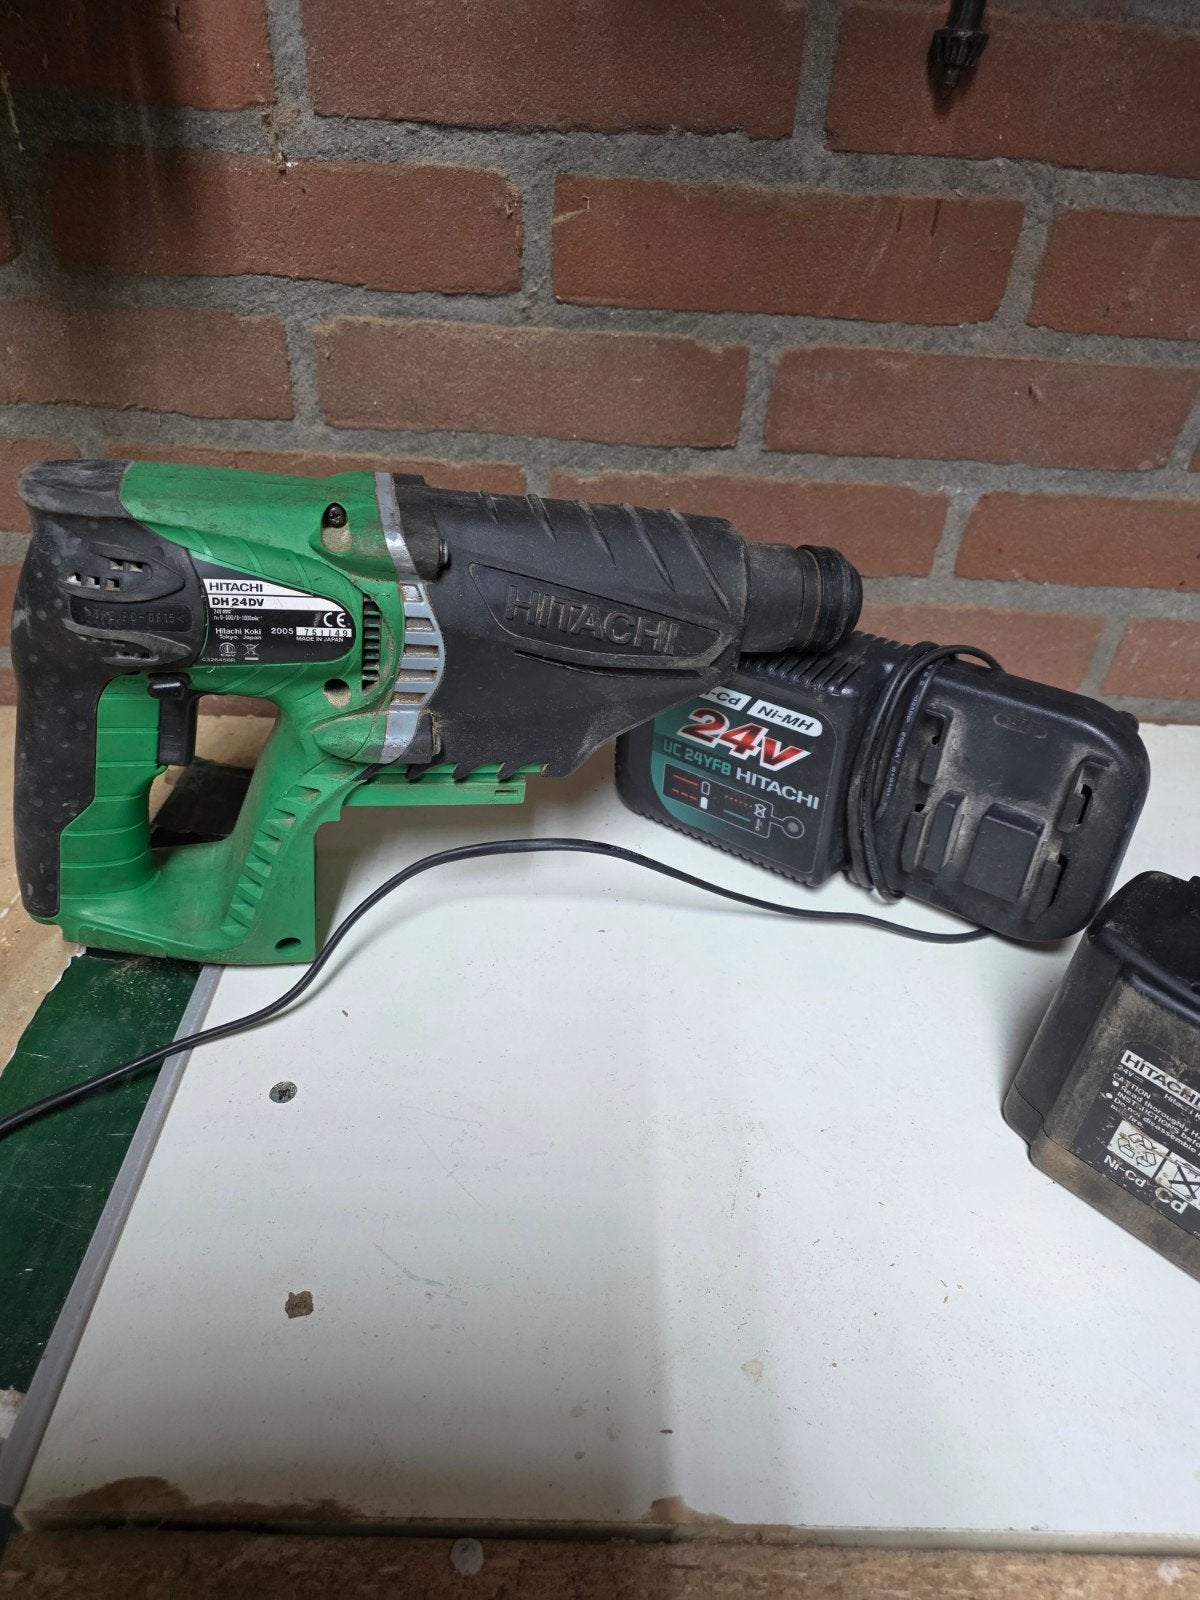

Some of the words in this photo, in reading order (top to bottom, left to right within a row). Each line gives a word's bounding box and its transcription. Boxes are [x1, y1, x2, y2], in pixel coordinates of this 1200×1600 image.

[209, 582, 263, 592] HITACHI
[212, 598, 231, 607] DH
[231, 598, 265, 608] 24DV
[215, 627, 242, 635] Hitachi
[270, 627, 294, 635] 2005
[505, 584, 679, 656] HITACHI
[705, 689, 742, 706] i-Cd
[757, 705, 814, 731] Ni-MH
[663, 739, 682, 757] UC
[677, 707, 811, 772] 24V
[736, 767, 820, 810] HITACHI
[1117, 1064, 1135, 1077] 24V
[1113, 1097, 1126, 1108] Do
[1142, 1116, 1197, 1154] disassemble
[1144, 1100, 1190, 1132] thoroughly
[1103, 1154, 1147, 1188] Ni-Cd
